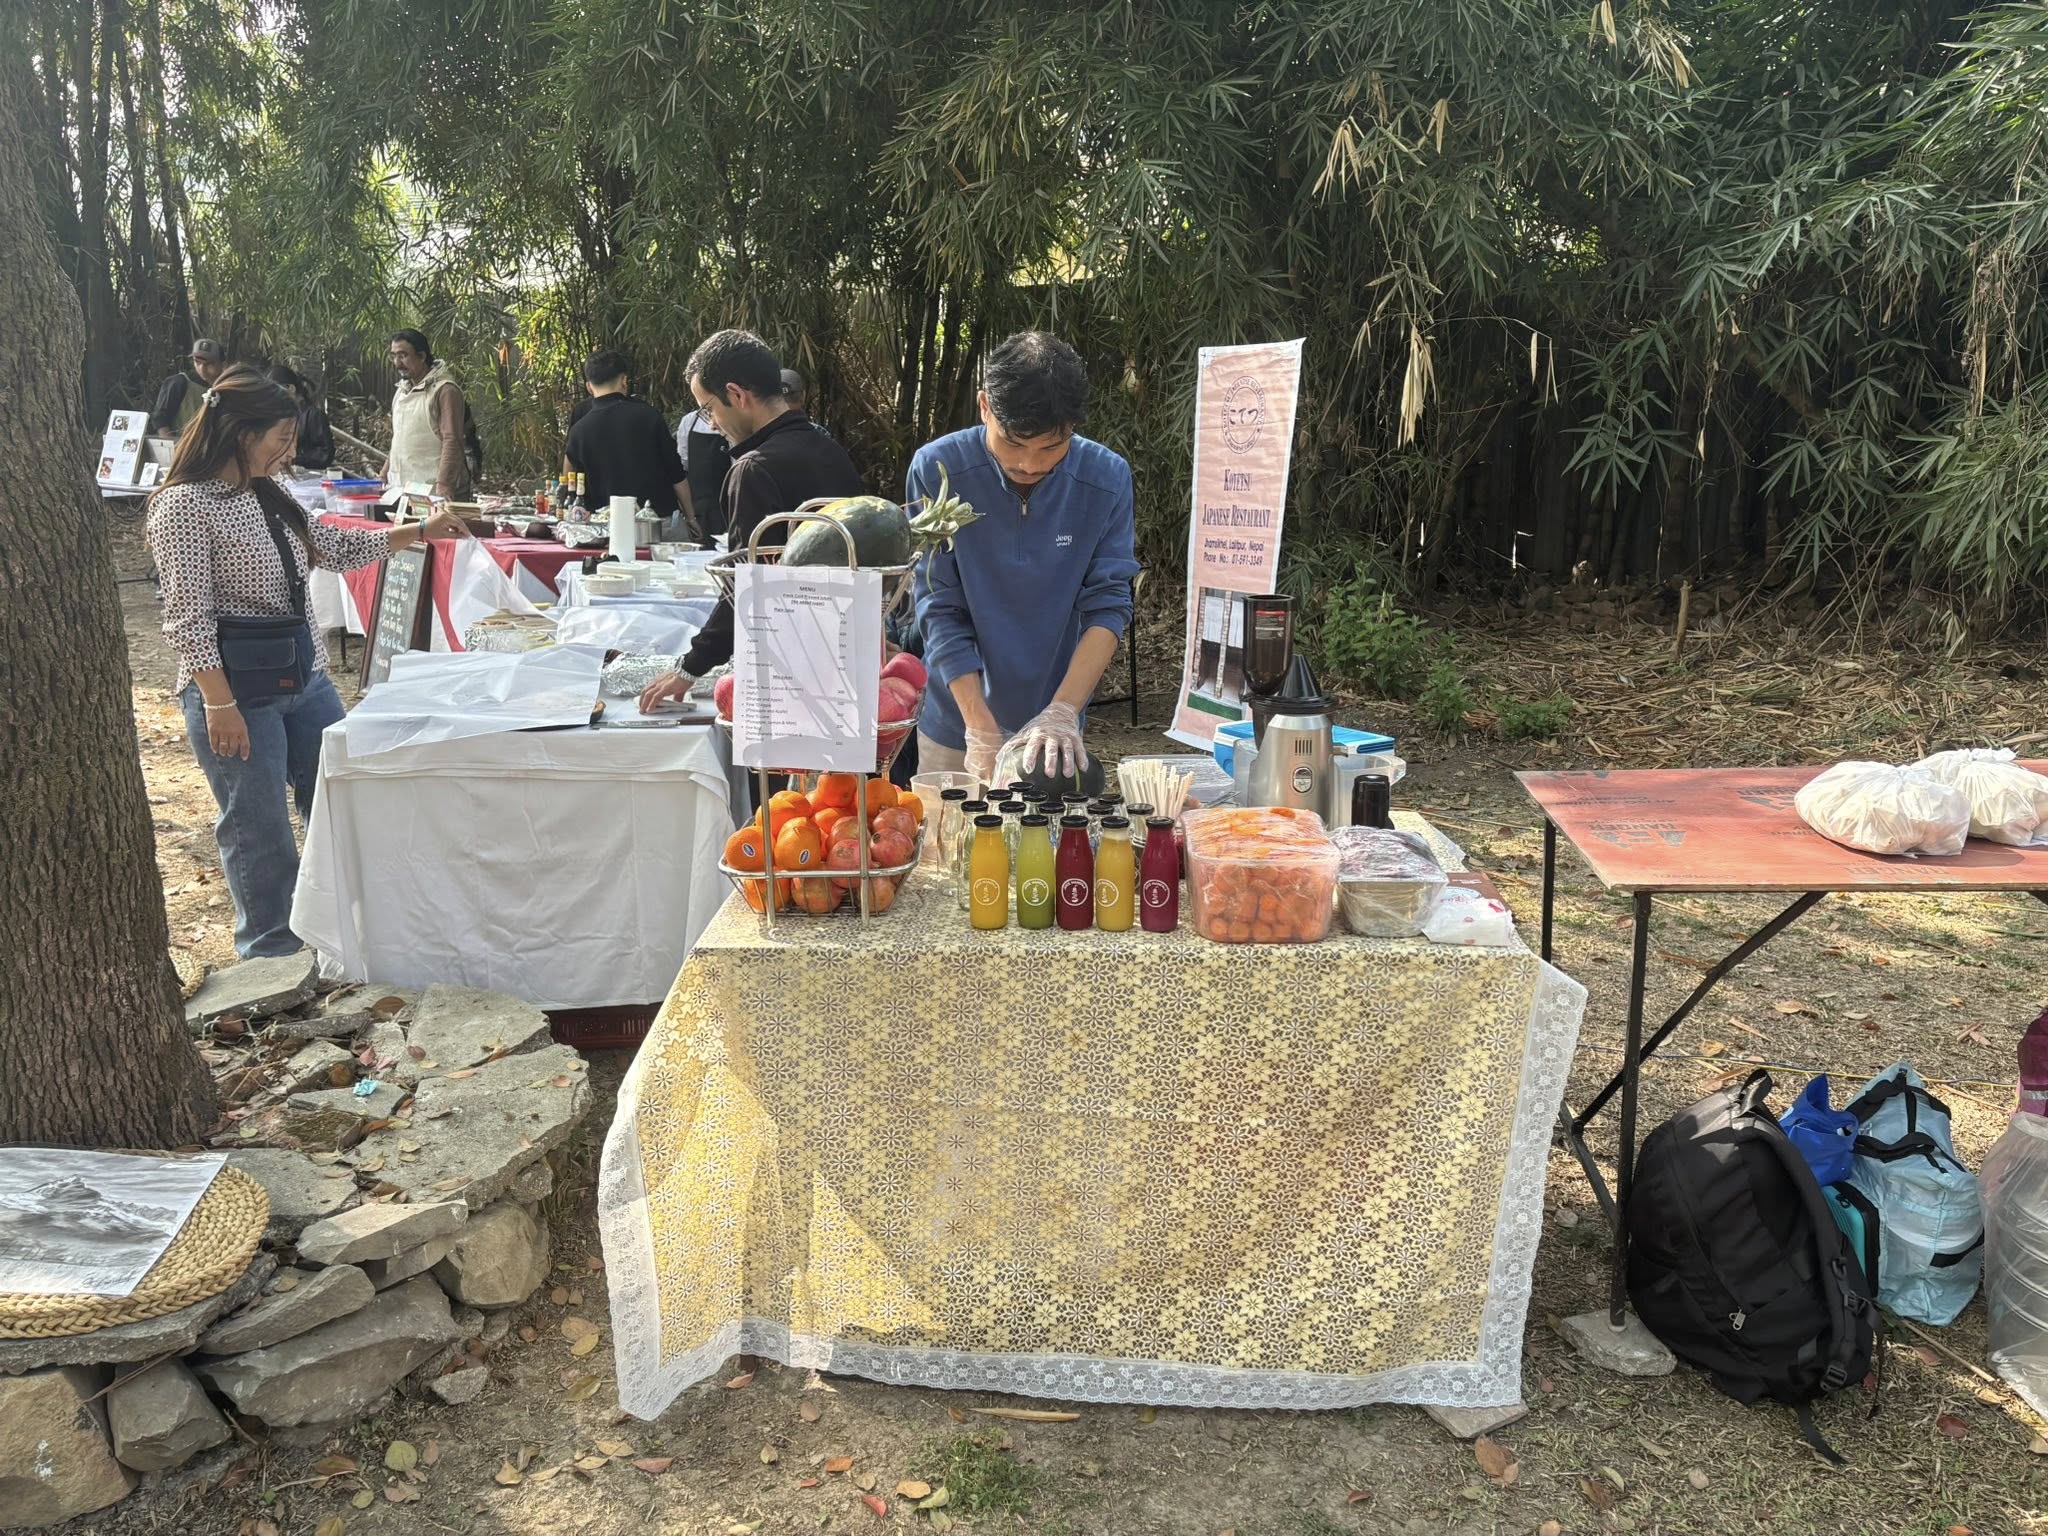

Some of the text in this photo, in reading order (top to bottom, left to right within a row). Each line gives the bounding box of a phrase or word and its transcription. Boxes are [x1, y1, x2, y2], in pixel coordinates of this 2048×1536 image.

[1202, 504, 1271, 528] JAPANESE RESTAURANT
[1249, 541, 1265, 553] Nepal
[1203, 552, 1216, 563] Phone
[1588, 823, 1677, 831] RANGER
